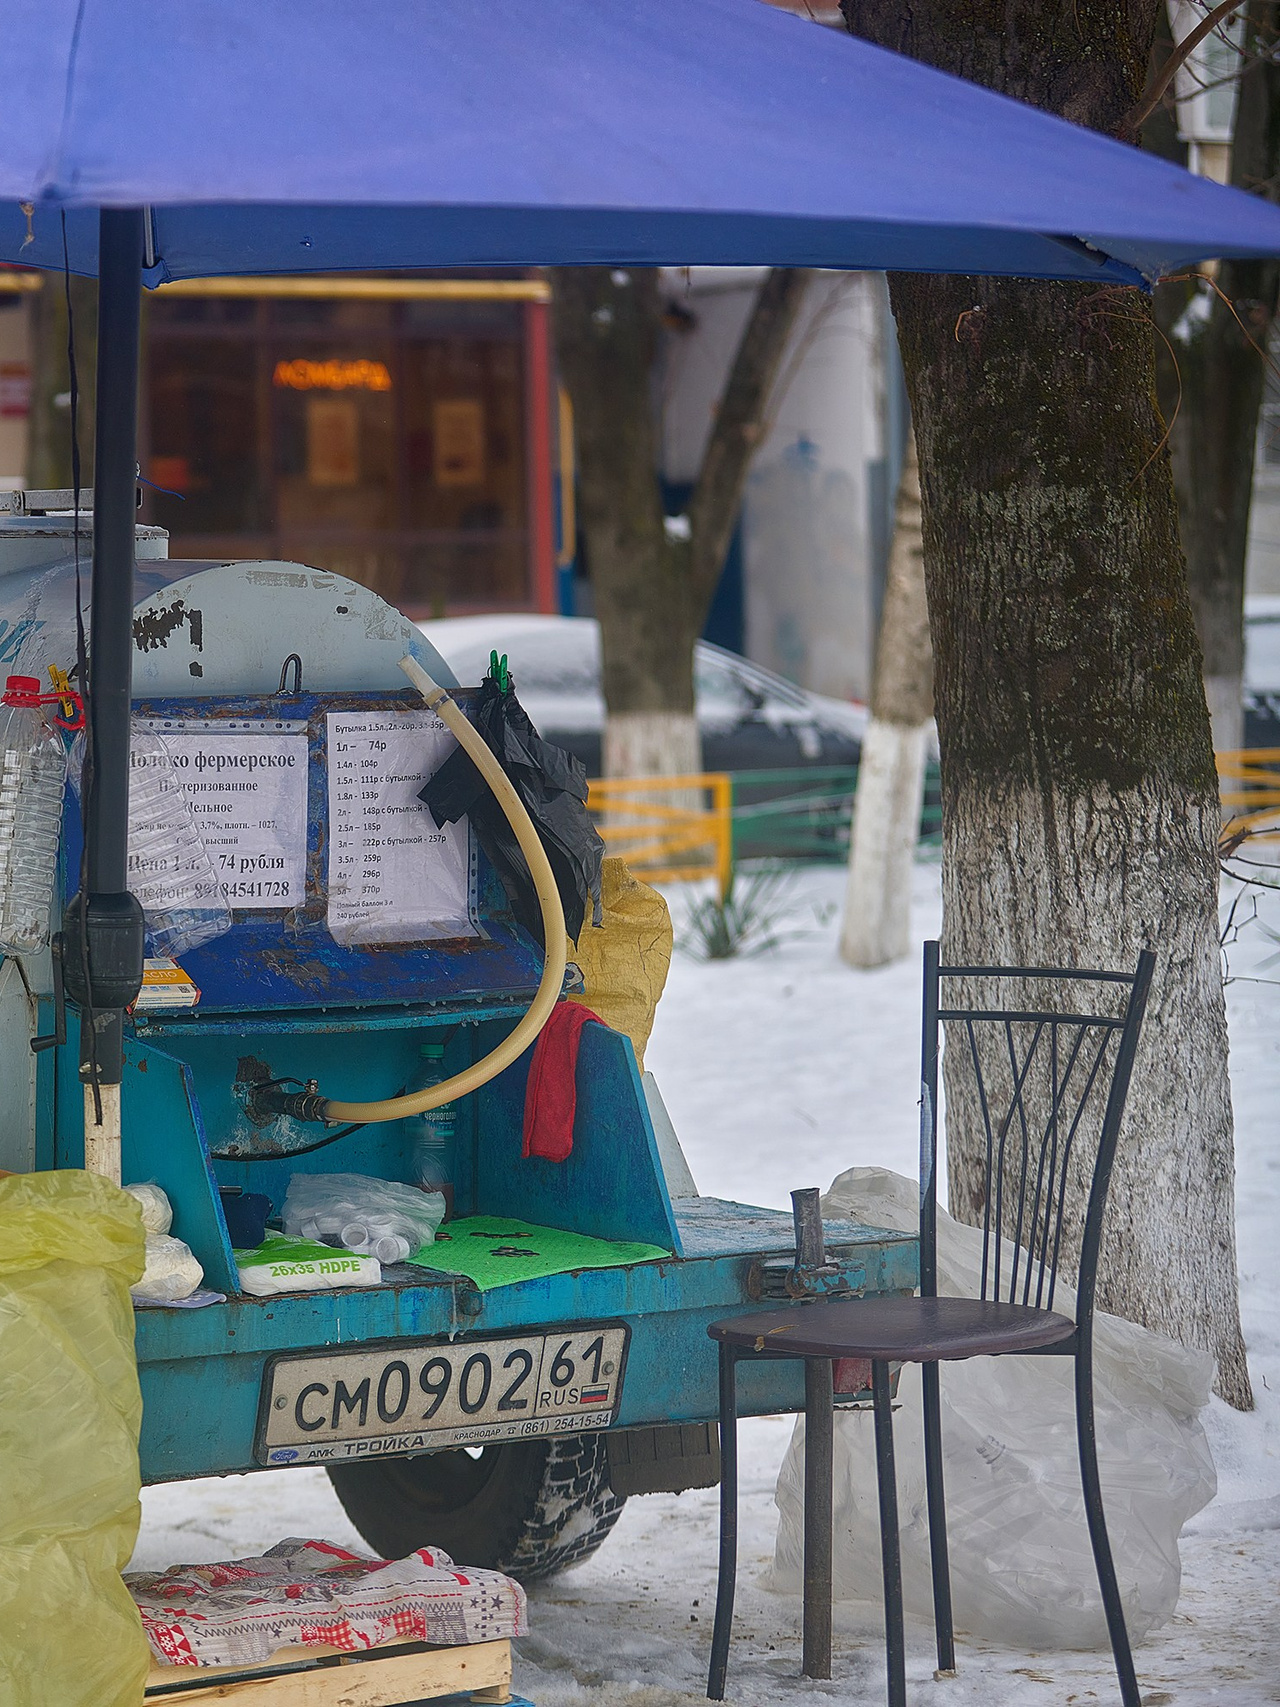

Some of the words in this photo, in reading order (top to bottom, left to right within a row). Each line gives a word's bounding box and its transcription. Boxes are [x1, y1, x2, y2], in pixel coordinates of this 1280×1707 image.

[335, 724, 367, 735] Бутылка
[336, 742, 348, 752] 1л
[368, 740, 387, 753] 74р
[194, 750, 296, 772] фермерское
[336, 761, 353, 769] 1.4л
[360, 760, 379, 769] 104р
[336, 776, 353, 785] 1.5л
[360, 775, 379, 785] 111р
[385, 772, 422, 784] бутылкой
[159, 779, 258, 794] Птеризованное
[336, 792, 353, 801] 1.8л
[361, 791, 379, 801] 133р
[337, 808, 347, 816] 2л
[362, 807, 381, 816] 148р
[386, 804, 423, 815] бутылкой
[337, 824, 354, 832] 2.5л
[363, 822, 381, 832] 185р
[205, 836, 239, 845] высший
[338, 840, 347, 848] 3л
[362, 838, 381, 848] 222р
[387, 835, 423, 846] бутылкой
[428, 834, 447, 845] 257р
[218, 854, 235, 870] 74
[240, 854, 285, 873] рубля
[337, 855, 354, 864] 3.5л
[363, 854, 382, 864] 259р
[336, 871, 347, 879] 4л
[362, 870, 381, 880] 296р
[361, 886, 381, 895] 370р
[270, 1263, 315, 1277] 26x35
[319, 1259, 361, 1275] HDPE
[549, 1336, 605, 1388] 61
[539, 1388, 580, 1409] RUS
[453, 1428, 502, 1442] КРАСНОДАР
[520, 1419, 551, 1437] (861)
[553, 1413, 610, 1432] 254-15-54
[307, 1448, 335, 1460] АМК
[344, 1435, 426, 1456] ТРОЙКА
[273, 1450, 297, 1462] Ford
